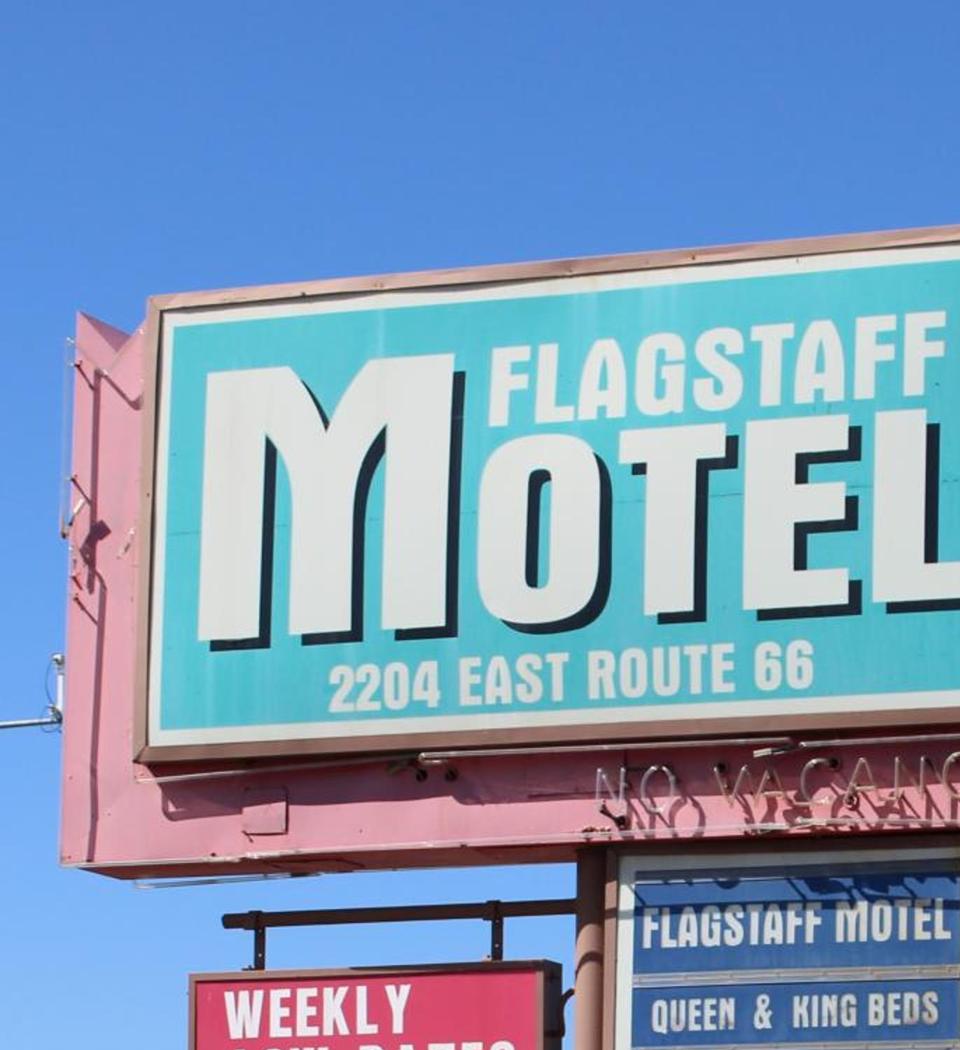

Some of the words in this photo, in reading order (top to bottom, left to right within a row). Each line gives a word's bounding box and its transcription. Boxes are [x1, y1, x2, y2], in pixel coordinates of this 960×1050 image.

[488, 311, 947, 427] FLAGSTAFF
[327, 660, 441, 713] 2204
[458, 653, 570, 706] EAST
[587, 643, 737, 700] ROUTE
[754, 640, 815, 691] 66
[594, 764, 677, 814] NO
[642, 903, 822, 949] FLAGSTAFF
[835, 898, 952, 944] MOTEL
[223, 984, 412, 1040] WEEKLY
[651, 997, 736, 1034] QUEEN
[753, 993, 773, 1030] &
[792, 994, 858, 1028] KING
[868, 991, 939, 1026] BEDS
